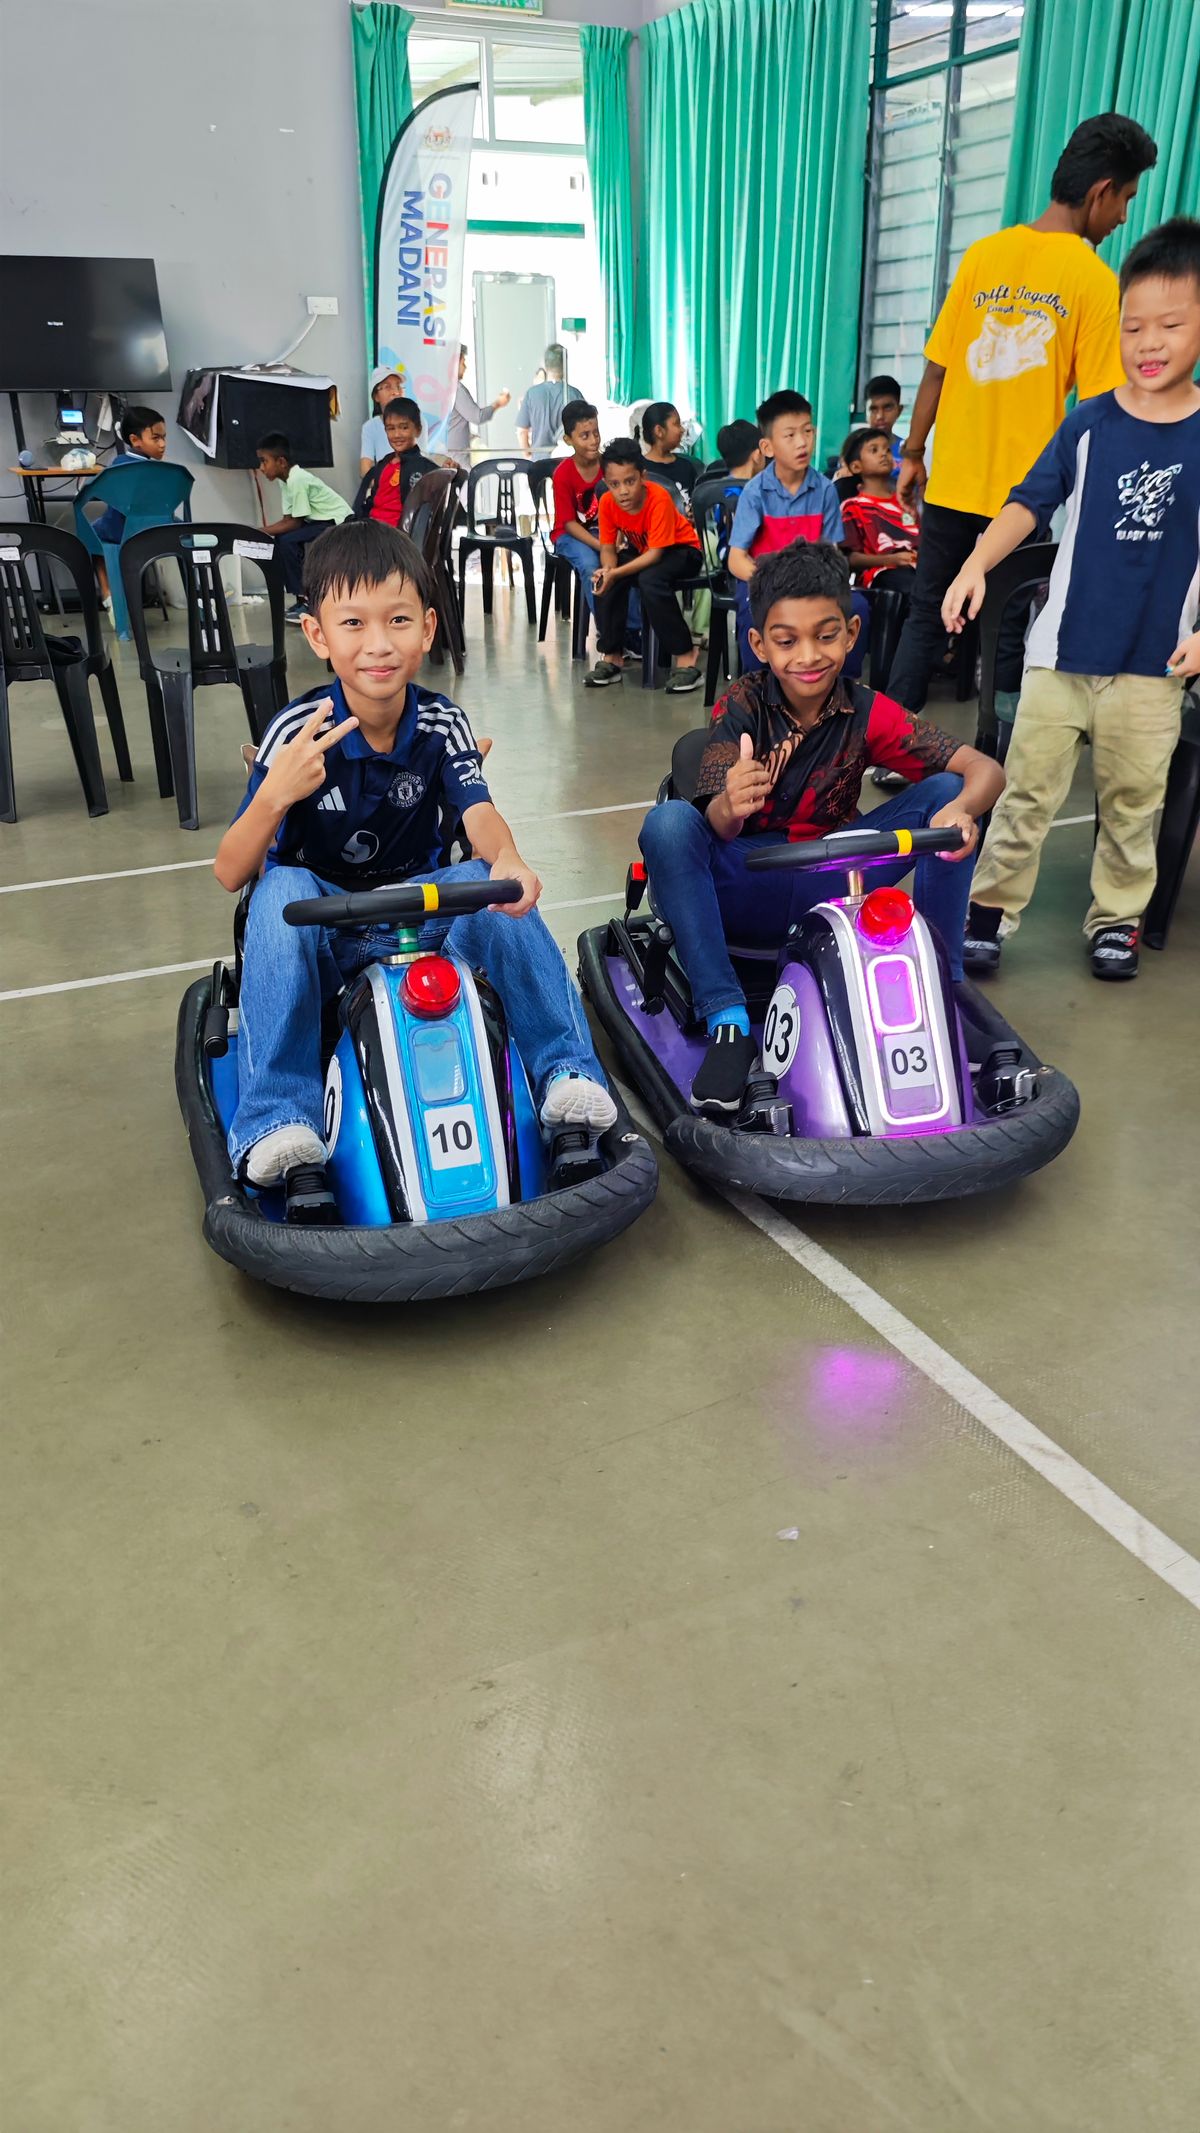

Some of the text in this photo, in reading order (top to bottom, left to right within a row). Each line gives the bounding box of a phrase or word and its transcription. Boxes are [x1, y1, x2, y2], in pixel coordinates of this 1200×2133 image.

[397, 190, 425, 327] MADANI
[423, 172, 452, 347] GENERASI
[973, 285, 1069, 318] Drift Together
[396, 796, 417, 806] UNITED
[764, 1003, 793, 1063] 03
[891, 1046, 928, 1075] 03
[432, 1120, 473, 1154] 10
